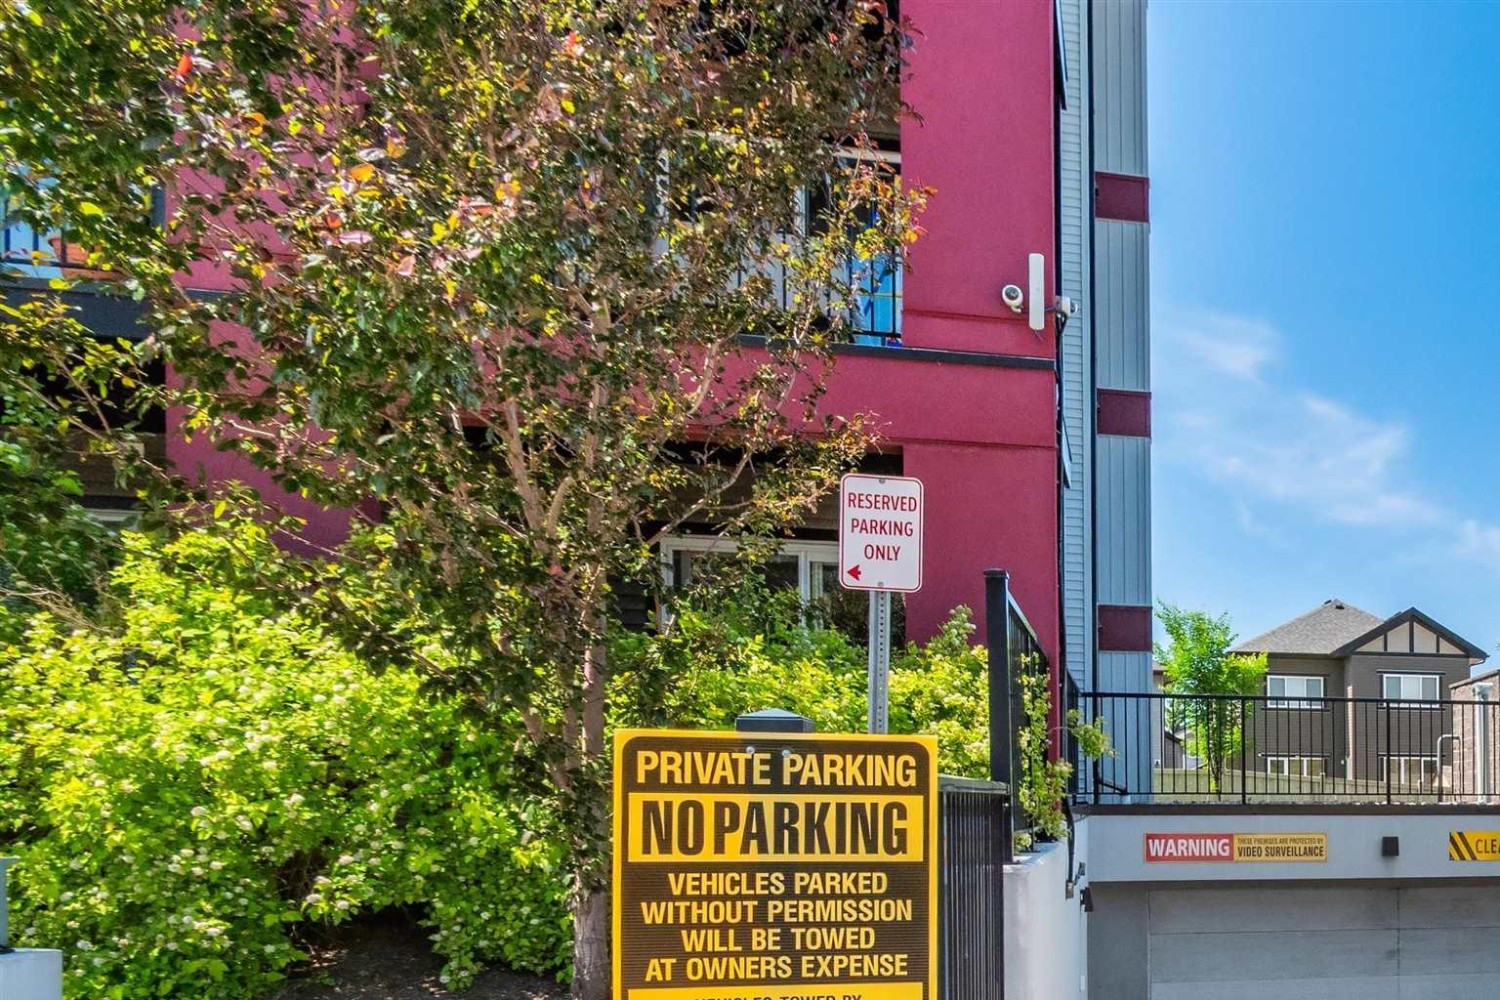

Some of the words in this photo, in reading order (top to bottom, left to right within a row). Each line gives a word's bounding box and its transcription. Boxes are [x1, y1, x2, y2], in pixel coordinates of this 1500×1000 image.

[848, 492, 917, 512] RESERVED
[851, 518, 914, 537] PARKING
[864, 544, 901, 561] ONLY
[636, 750, 771, 786] PRIVATE
[782, 753, 917, 788] PARKING
[641, 800, 704, 856] NO
[713, 800, 908, 856] PARKING
[1148, 838, 1230, 857] WARNING
[1237, 846, 1262, 857] VIDEO
[1265, 846, 1324, 857] SURVEILLANCE
[668, 872, 785, 895] VEHICLES
[794, 872, 888, 895] PARKED
[640, 901, 758, 924] WITHOUT
[768, 899, 912, 923] PERMISSION
[681, 929, 742, 952] WILL
[752, 928, 781, 951] BE
[791, 927, 875, 950] TOWED
[645, 958, 676, 982] AT
[686, 955, 792, 981] OWNERS
[801, 954, 908, 978] EXPENSE
